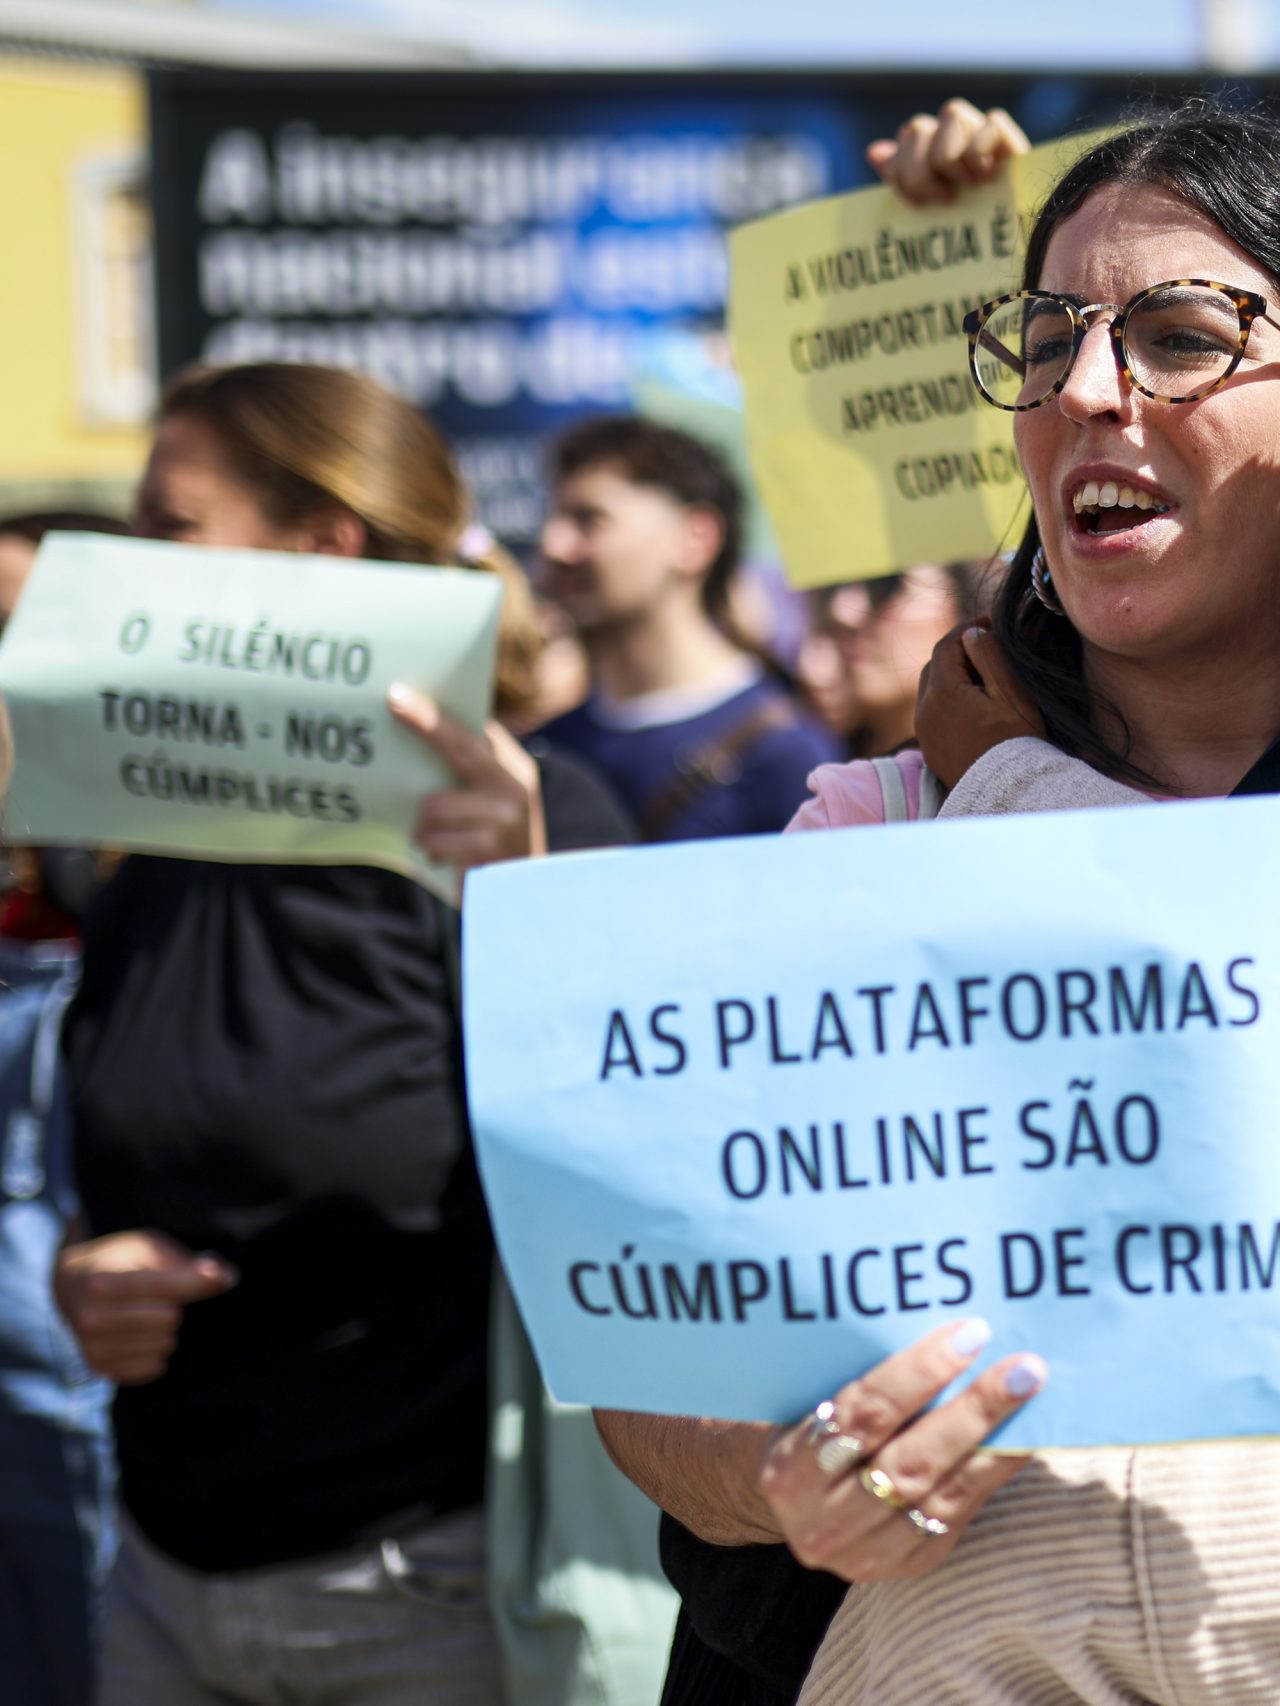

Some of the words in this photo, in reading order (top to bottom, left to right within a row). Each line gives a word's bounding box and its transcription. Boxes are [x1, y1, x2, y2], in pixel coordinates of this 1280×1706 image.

[785, 262, 808, 306] A
[808, 225, 981, 294] VIOLÊNCIA
[118, 611, 152, 655] O
[98, 685, 247, 751] TORNA
[285, 709, 376, 769] NOS
[118, 748, 364, 825] CÚMPLICES
[598, 1004, 688, 1083] AS
[715, 956, 1263, 1071] PLATAFORMAS
[720, 1106, 997, 1202] ONLINE
[1017, 1077, 1161, 1173] SÃO
[567, 1239, 975, 1323] CÚMPLICES
[999, 1227, 1092, 1302] DE
